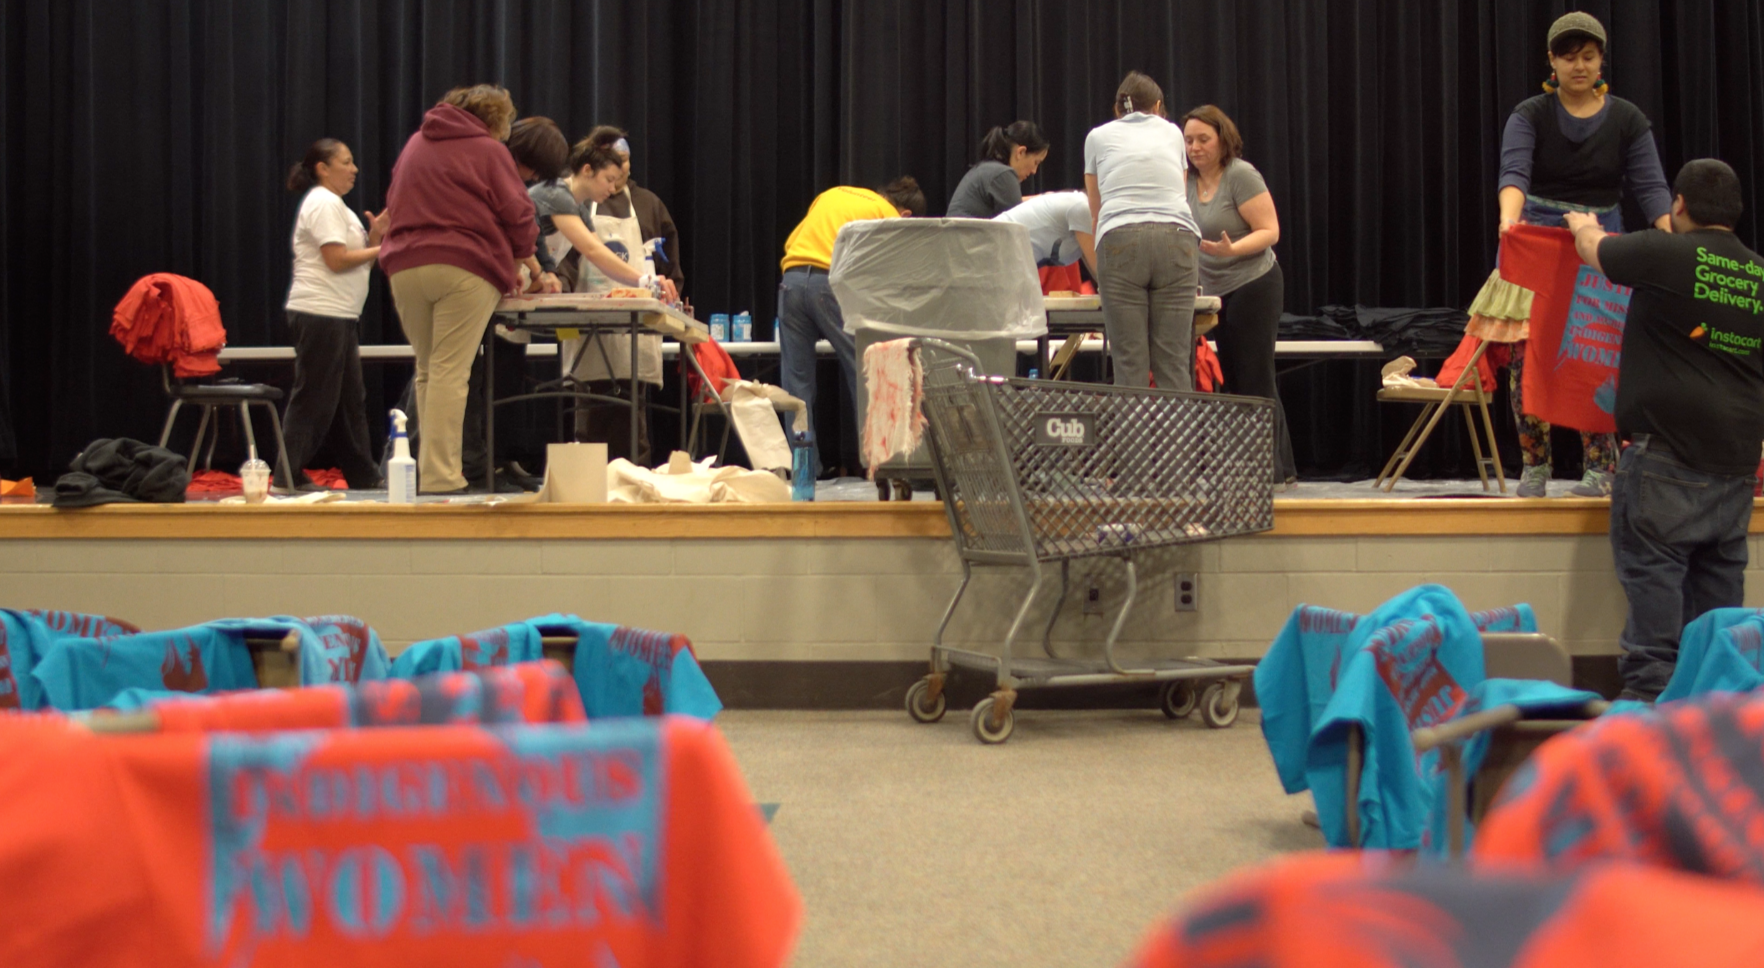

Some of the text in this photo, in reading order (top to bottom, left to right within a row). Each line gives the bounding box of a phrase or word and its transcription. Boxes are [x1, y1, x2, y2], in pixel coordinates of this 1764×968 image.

[1695, 264, 1759, 297] Grocery
[1576, 294, 1601, 309] FOR
[1694, 282, 1764, 315] Delivery.
[1573, 309, 1594, 322] AND
[1711, 327, 1762, 349] instacart
[1046, 417, 1085, 438] Cub
[232, 749, 644, 820] INDIGENOUS
[230, 831, 650, 940] WOMEN
